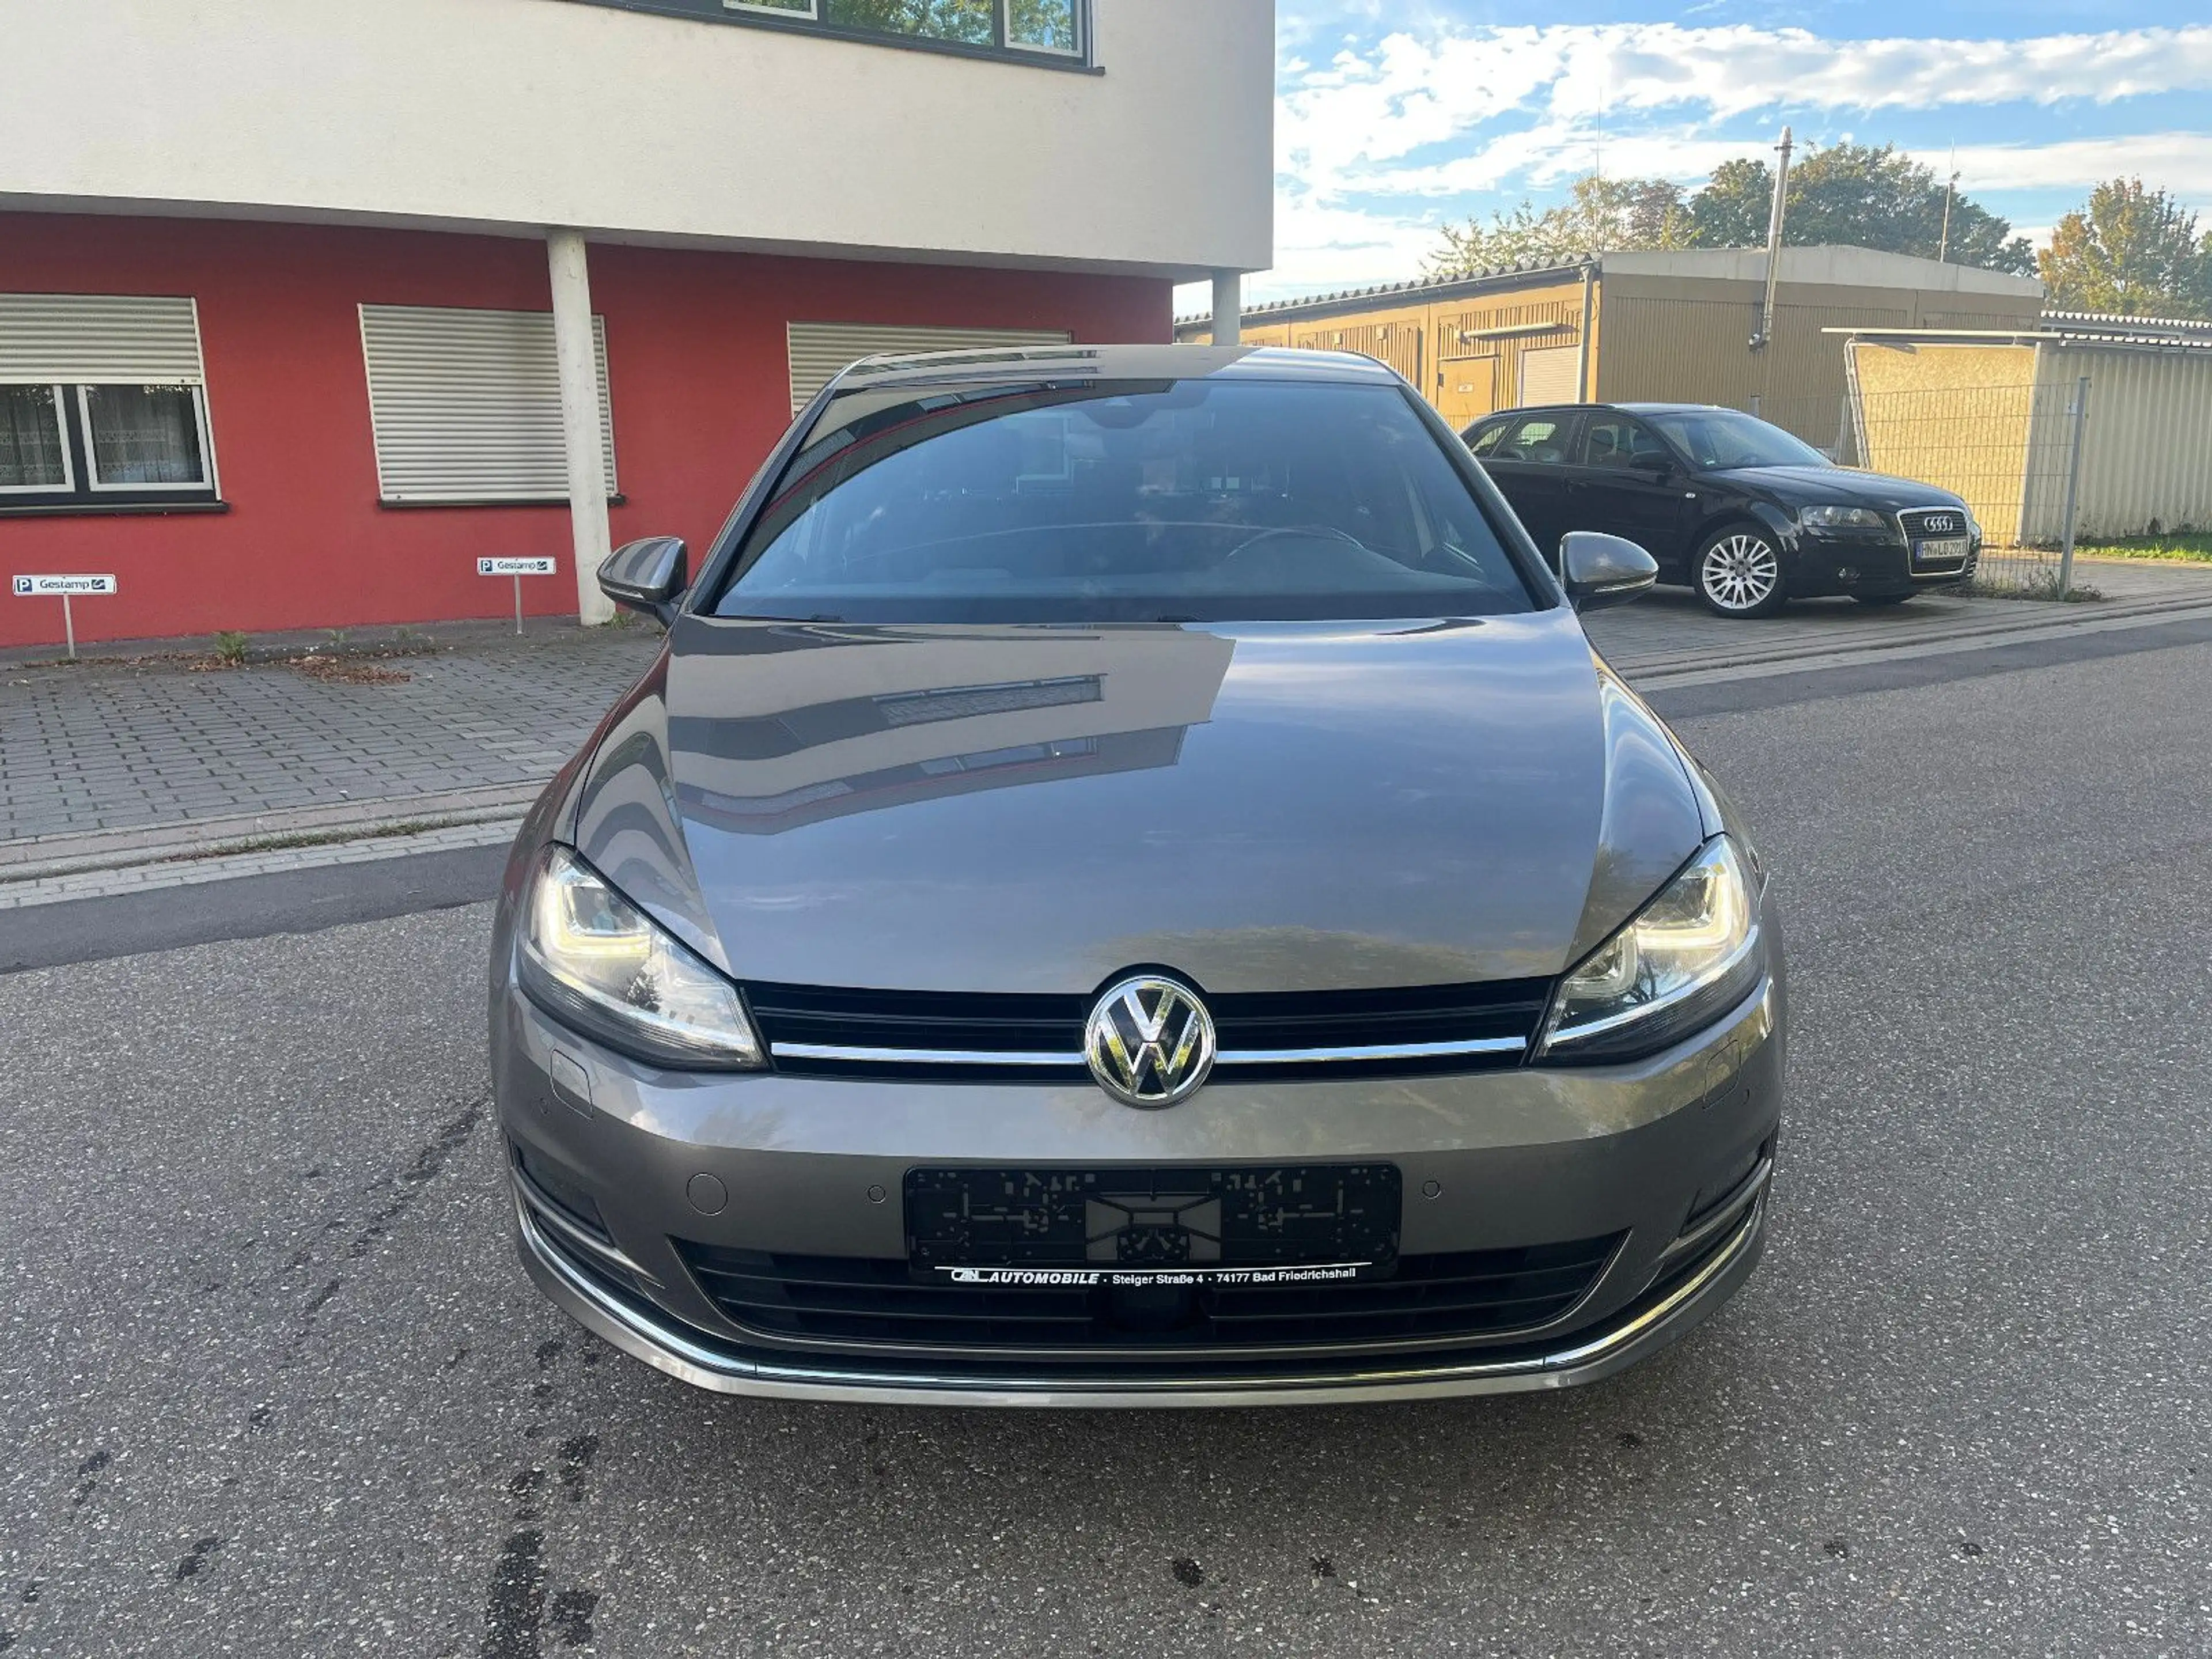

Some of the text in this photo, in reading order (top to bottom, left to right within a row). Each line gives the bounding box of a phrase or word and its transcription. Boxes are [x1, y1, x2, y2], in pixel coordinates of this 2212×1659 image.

[497, 561, 536, 570] Gestamp
[40, 579, 89, 589] Gestamp
[988, 1271, 1100, 1284] AUTOMOBILE
[1112, 1274, 1153, 1287] Steiger
[1156, 1274, 1194, 1284] Straße
[1196, 1274, 1203, 1283] 4
[1217, 1273, 1250, 1283] 74177
[1252, 1272, 1275, 1282] Bad
[1278, 1268, 1355, 1281] Friedrichshall
